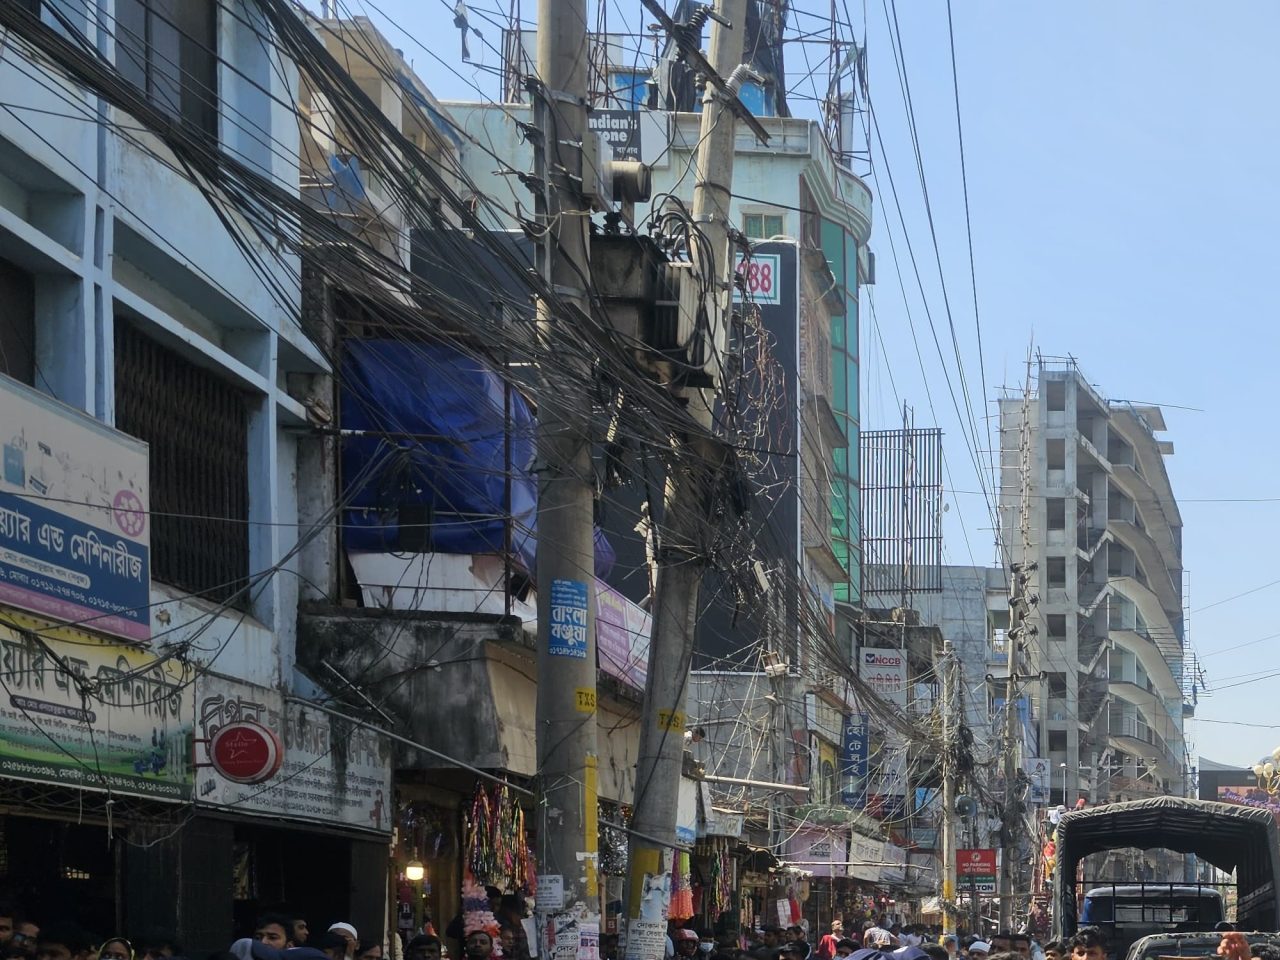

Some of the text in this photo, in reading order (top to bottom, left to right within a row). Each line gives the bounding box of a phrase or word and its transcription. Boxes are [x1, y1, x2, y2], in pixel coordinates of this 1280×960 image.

[588, 113, 637, 130] ndian's
[70, 530, 142, 583] মেশিনারীজ
[551, 604, 588, 627] বাংলা
[875, 656, 901, 665] NCCB
